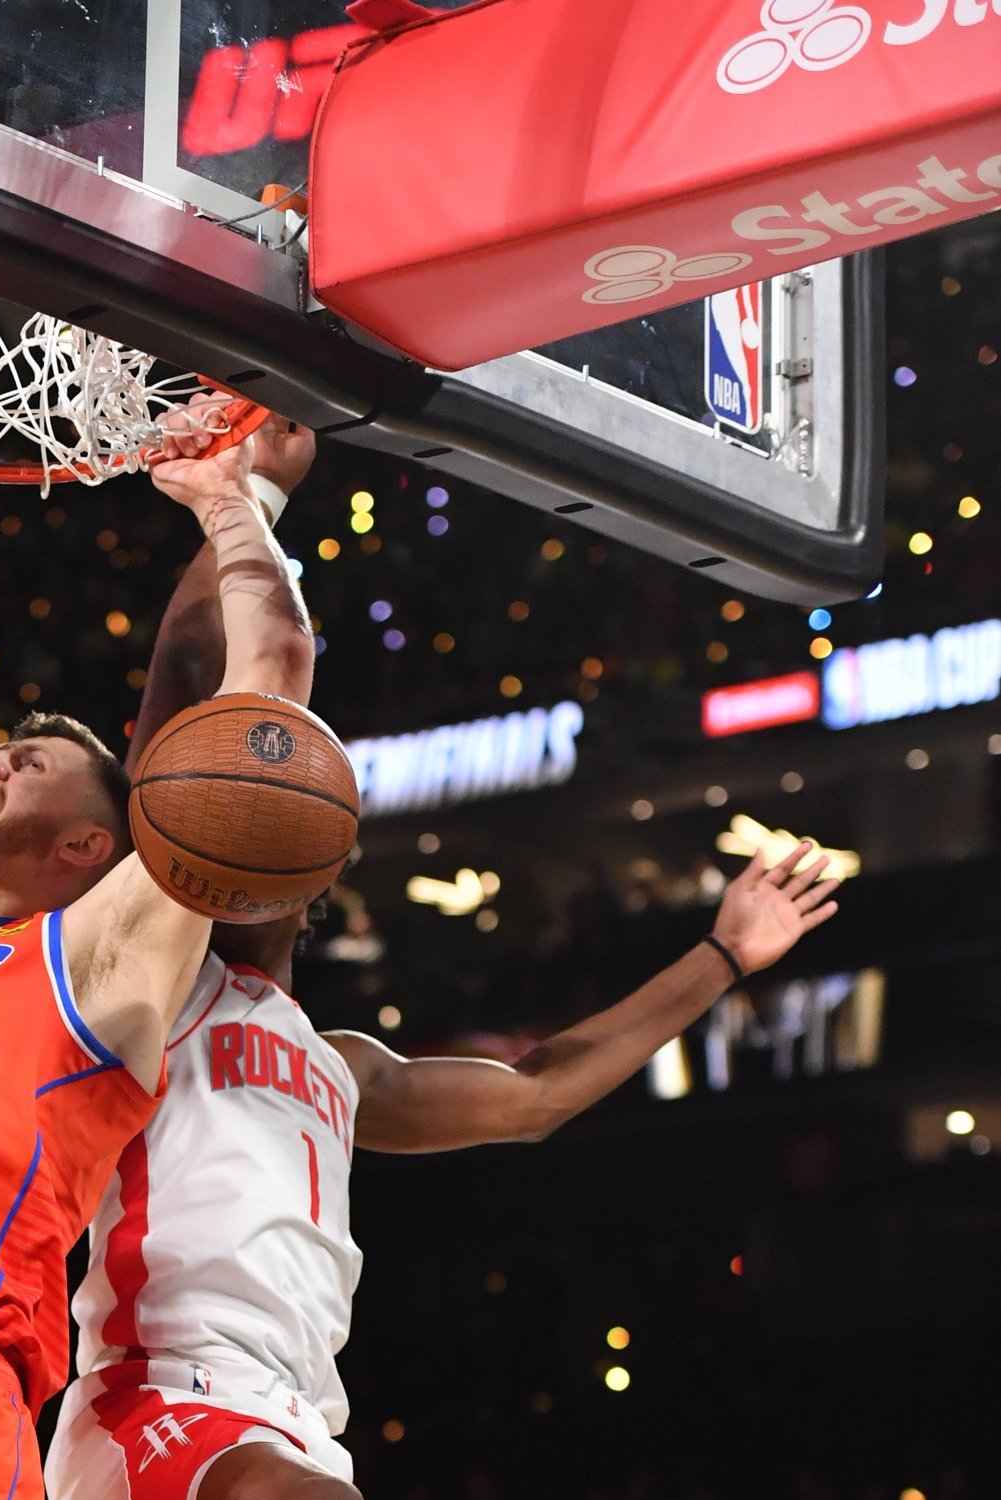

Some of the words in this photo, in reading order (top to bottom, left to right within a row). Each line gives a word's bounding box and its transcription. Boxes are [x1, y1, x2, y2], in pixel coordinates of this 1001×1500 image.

[731, 156, 1001, 255] Stat
[714, 373, 741, 415] NBA
[301, 1130, 320, 1228] 1
